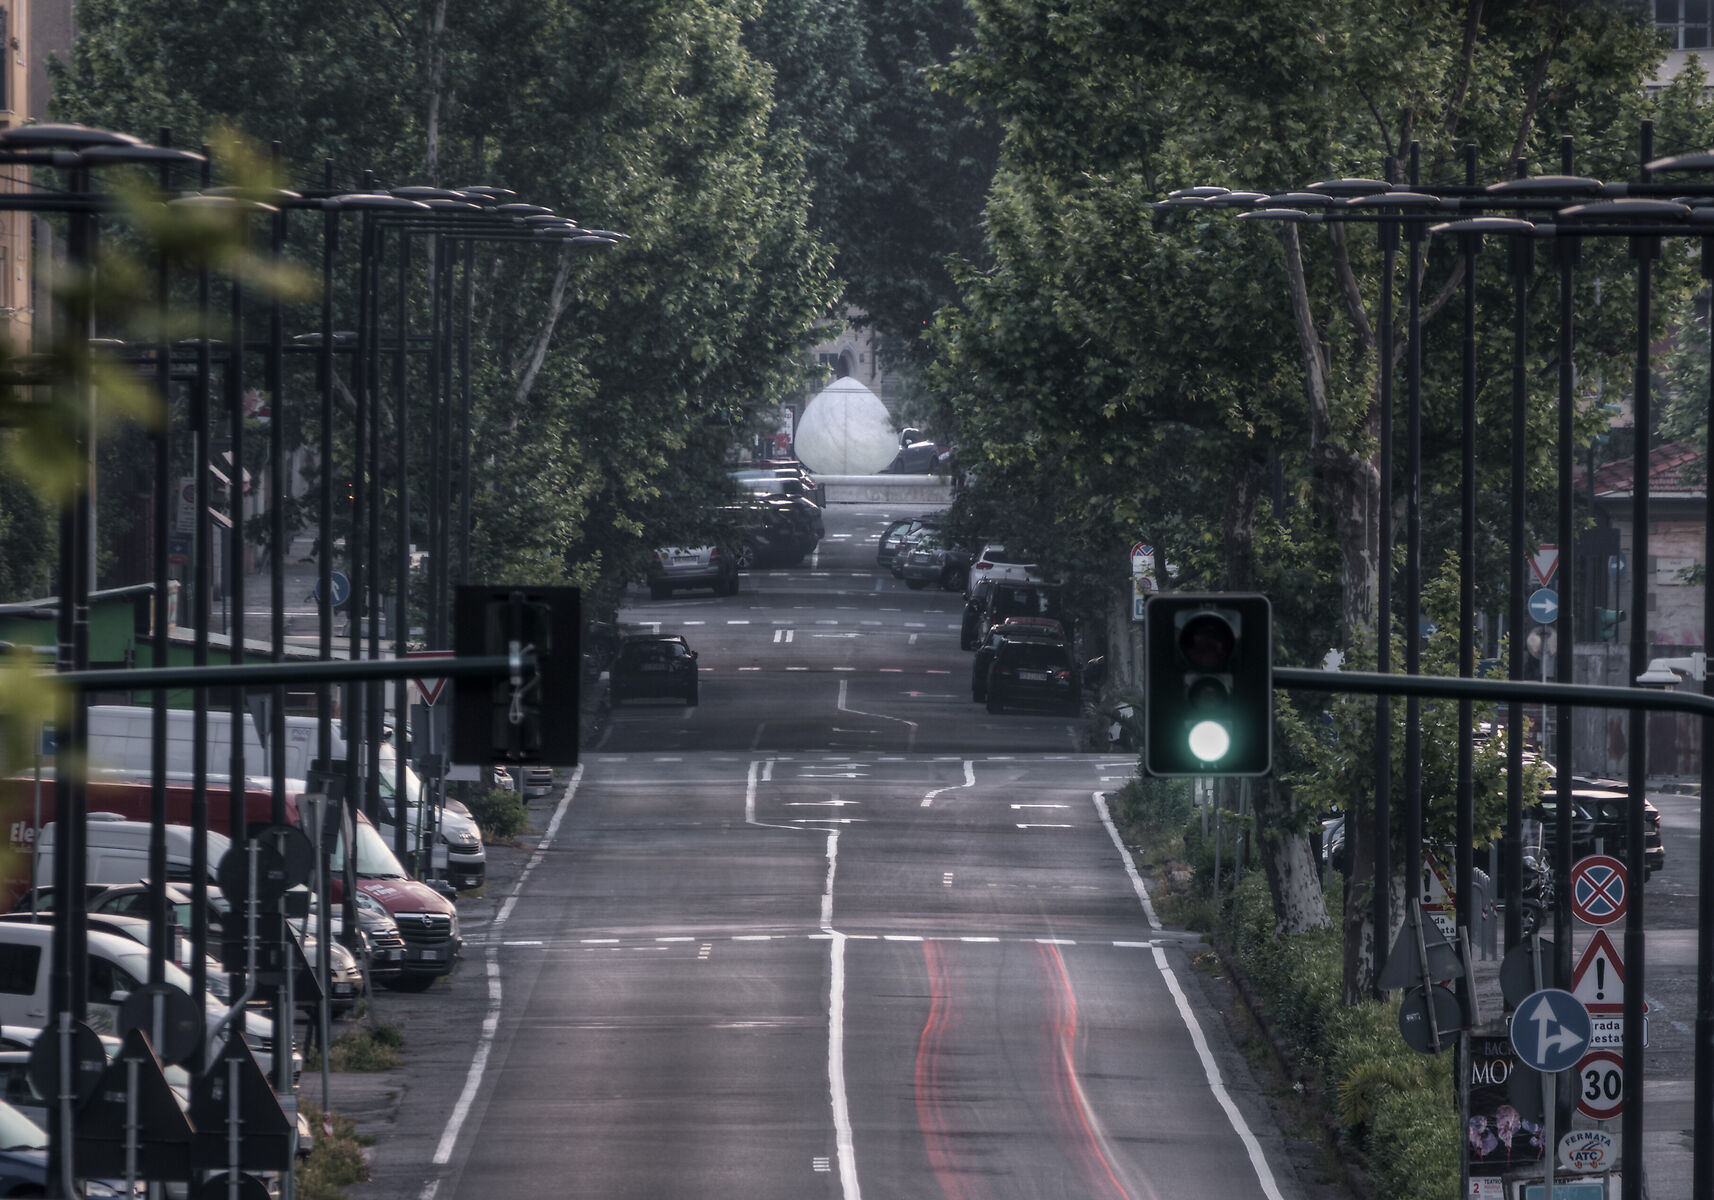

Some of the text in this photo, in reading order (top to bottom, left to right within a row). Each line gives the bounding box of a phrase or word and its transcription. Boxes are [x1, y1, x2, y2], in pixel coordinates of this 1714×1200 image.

[1472, 1059, 1514, 1085] MO
[1585, 1069, 1621, 1100] 30
[1565, 1132, 1611, 1147] FERMATA
[1575, 1151, 1598, 1161] ATC
[1473, 1183, 1480, 1194] 2
